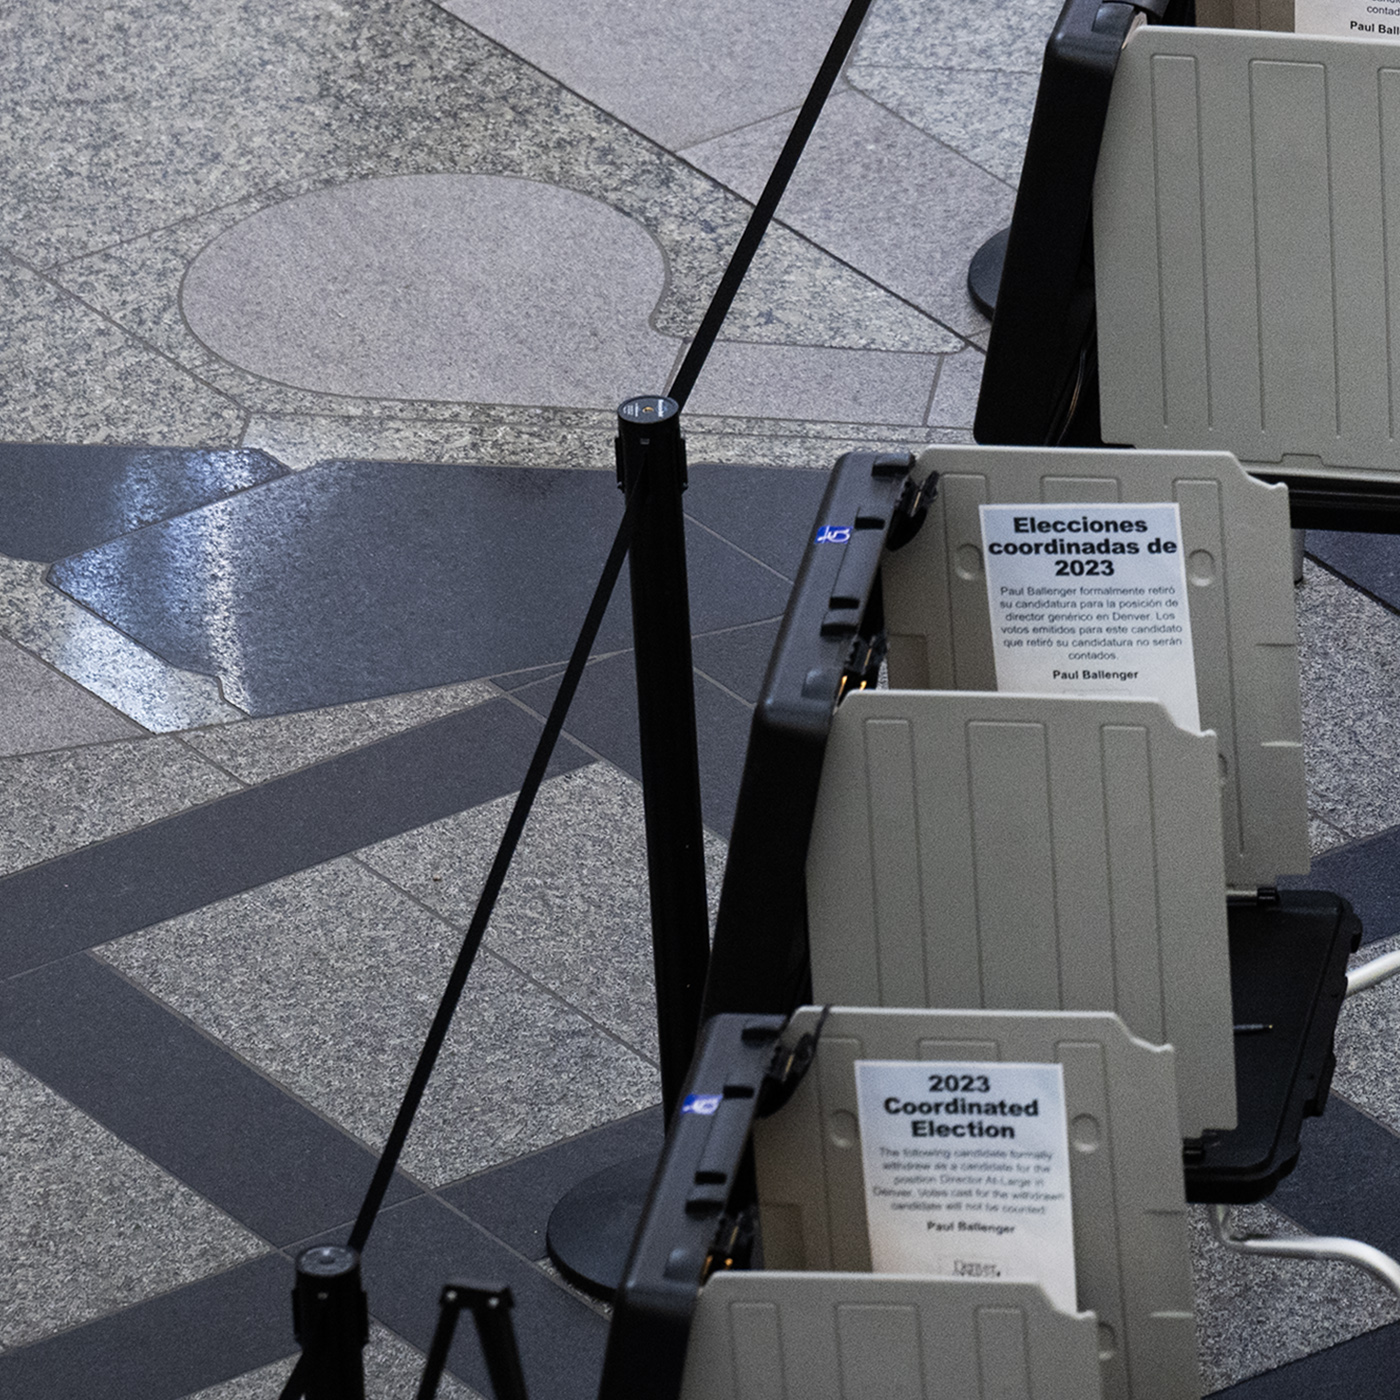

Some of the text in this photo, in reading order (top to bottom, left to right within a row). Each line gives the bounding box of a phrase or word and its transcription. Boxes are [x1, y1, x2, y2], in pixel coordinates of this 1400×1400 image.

[1350, 21, 1375, 32] Paul
[1013, 516, 1148, 533] Elecciones
[988, 538, 1177, 555] coordinadas de
[1055, 560, 1115, 576] 2023
[1000, 586, 1176, 597] Paul Ballenger formalmente retiró
[999, 599, 1179, 610] su candidatura para la posición de
[1005, 613, 1045, 621] director
[1047, 613, 1094, 623] genérico
[1156, 612, 1175, 620] Los
[1000, 625, 1183, 636] votos emitidos para este candidato
[1003, 639, 1024, 648] que
[1026, 638, 1054, 647] retiró
[1071, 638, 1133, 647] candidatura
[1152, 637, 1182, 646] serán
[1052, 670, 1138, 681] Paul Ballenger
[928, 1075, 991, 1093] 2023
[883, 1097, 1039, 1117] Coordinated
[911, 1120, 1015, 1139] Election
[927, 1221, 1015, 1235] Paul Ballenger
